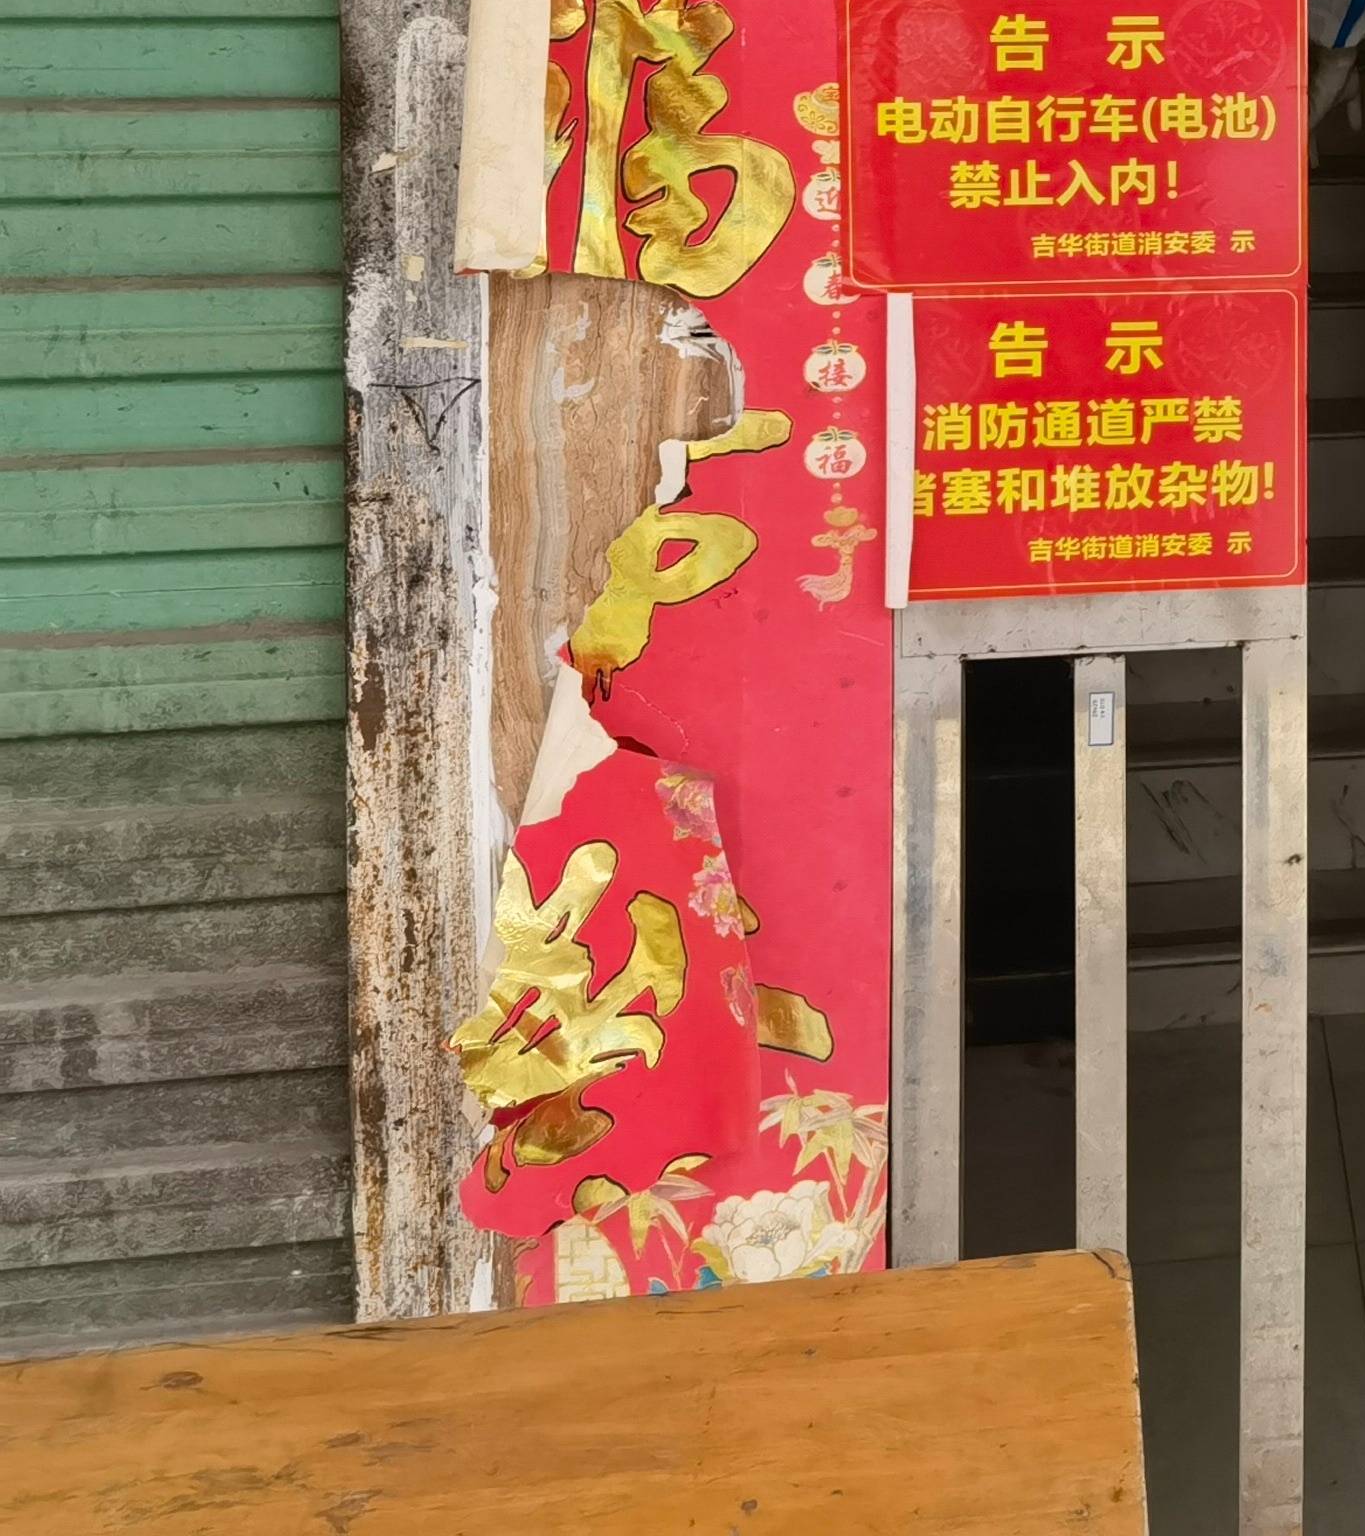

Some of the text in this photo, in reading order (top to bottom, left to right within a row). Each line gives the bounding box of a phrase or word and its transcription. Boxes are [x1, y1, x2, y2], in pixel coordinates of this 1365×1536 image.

[875, 92, 1278, 145] 电动自行车(电池)
[949, 160, 1179, 209] 禁止入内!
[1031, 231, 1216, 259] 吉华街道消安委
[922, 396, 1244, 452] 消防通道严禁
[1029, 534, 1213, 563] 吉华街道消安委
